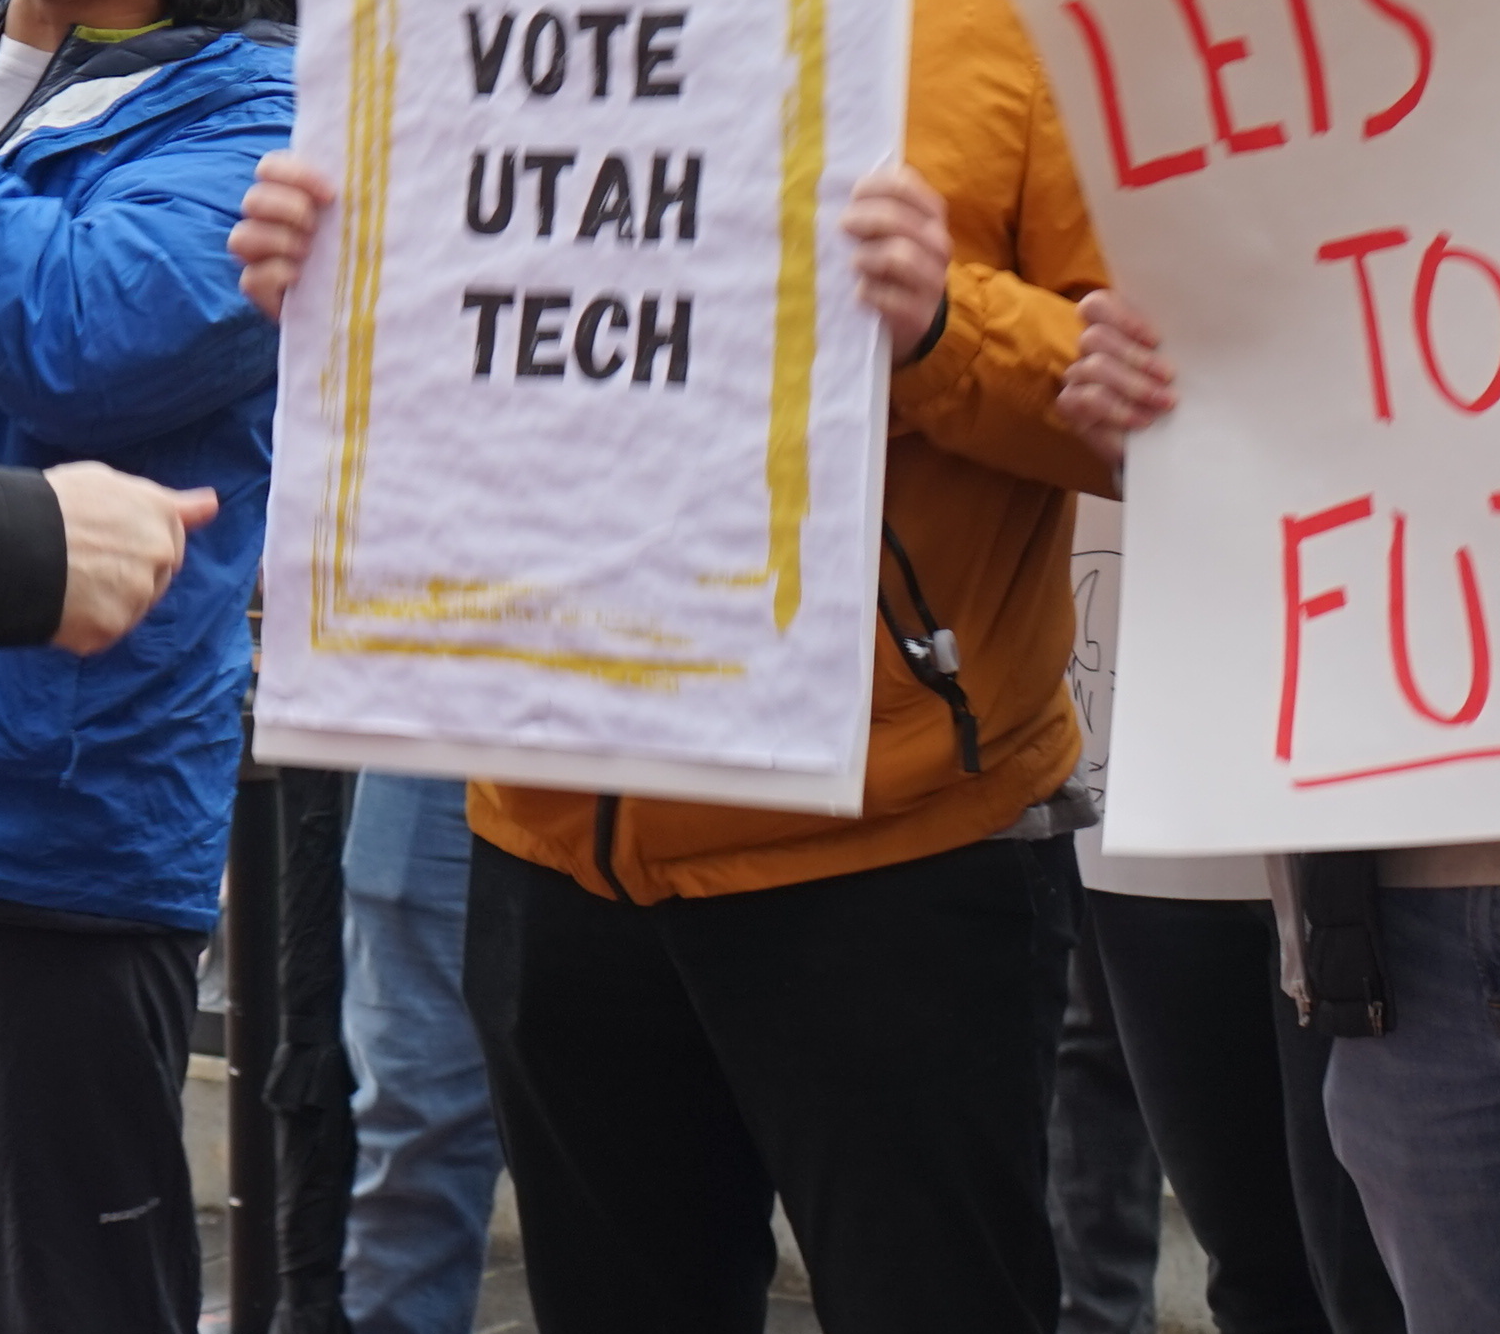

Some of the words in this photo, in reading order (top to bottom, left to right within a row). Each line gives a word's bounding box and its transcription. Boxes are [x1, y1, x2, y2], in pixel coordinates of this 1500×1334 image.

[466, 10, 687, 99] VOTE
[466, 152, 702, 241] UTAH
[462, 290, 693, 384] TECH
